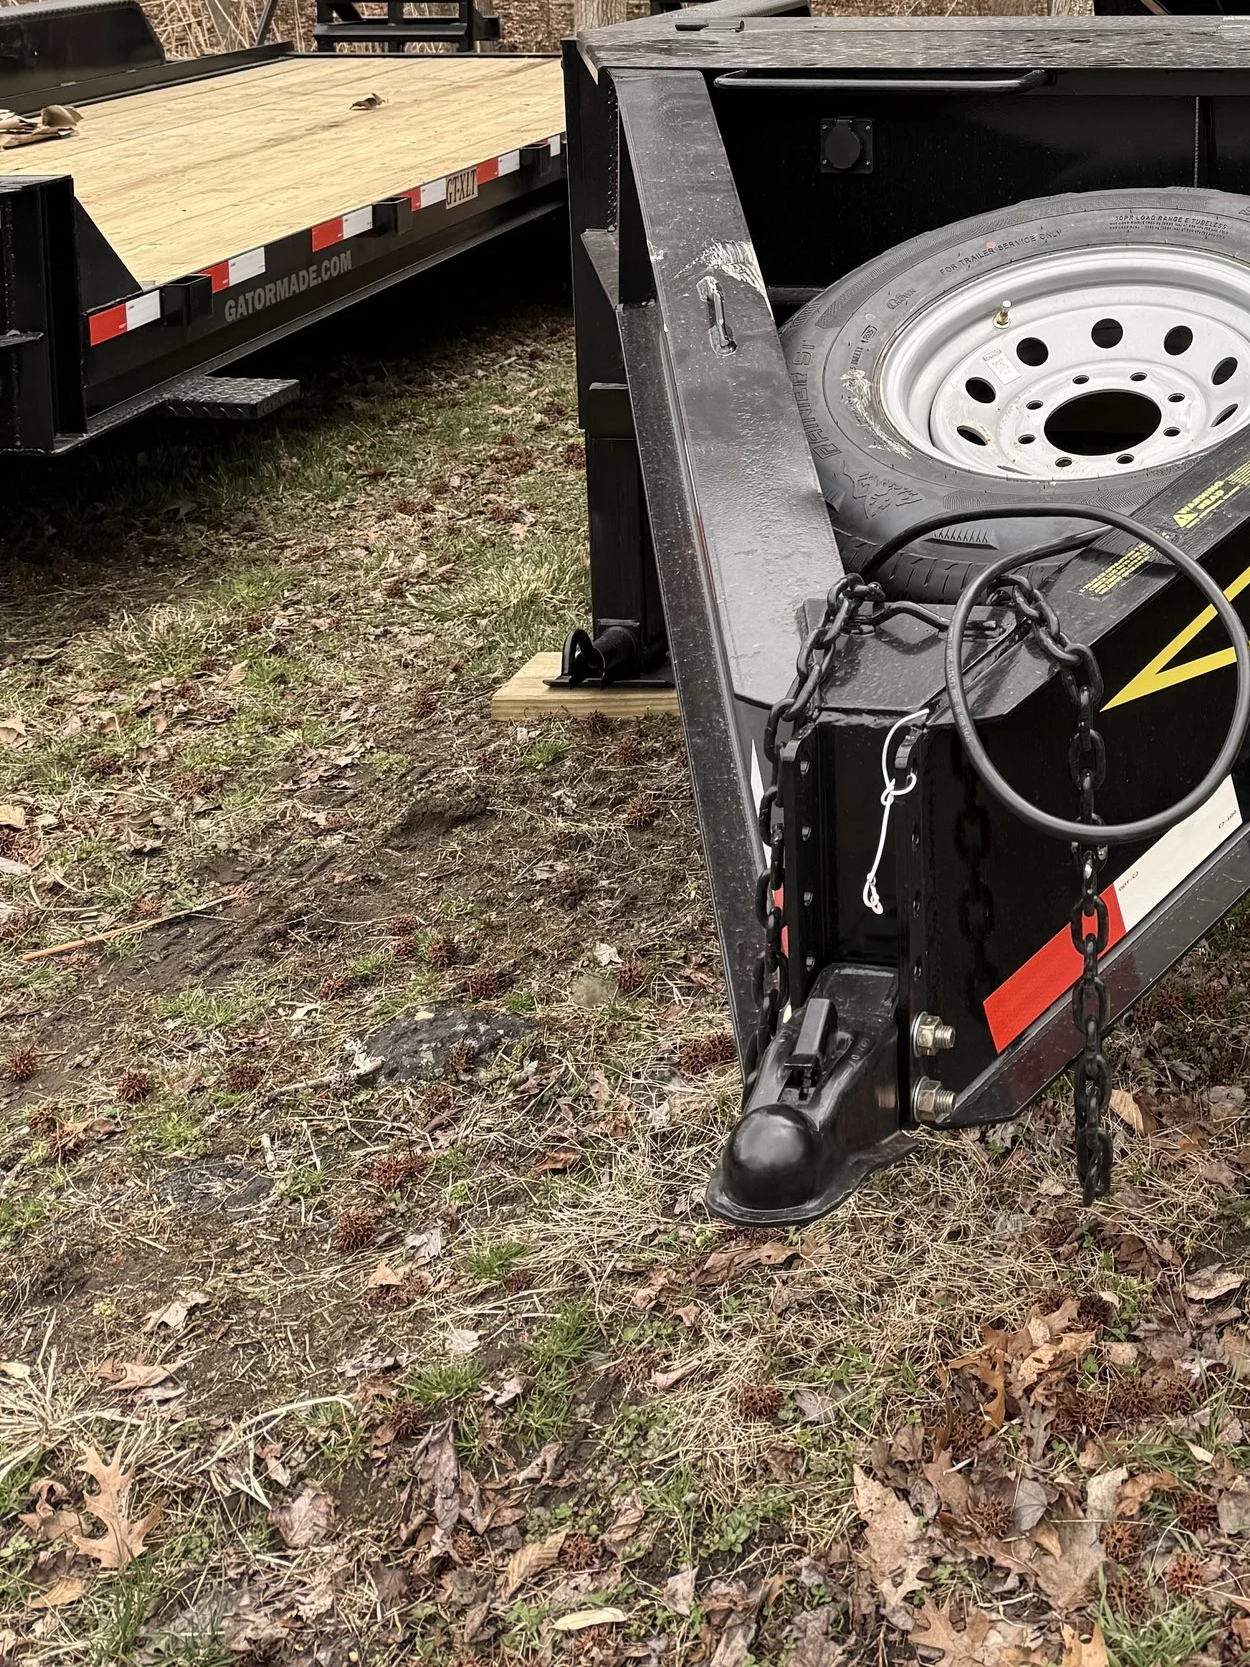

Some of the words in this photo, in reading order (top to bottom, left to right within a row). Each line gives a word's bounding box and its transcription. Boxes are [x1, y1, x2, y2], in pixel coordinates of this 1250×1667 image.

[1157, 215, 1182, 224] RANGE
[1191, 218, 1227, 230] TUBELESS
[940, 264, 959, 276] FOR
[959, 247, 996, 267] TRAILER
[997, 235, 1036, 252] SERVICE
[1039, 230, 1062, 241] ONLY
[225, 250, 352, 322] GATORMADE.COM
